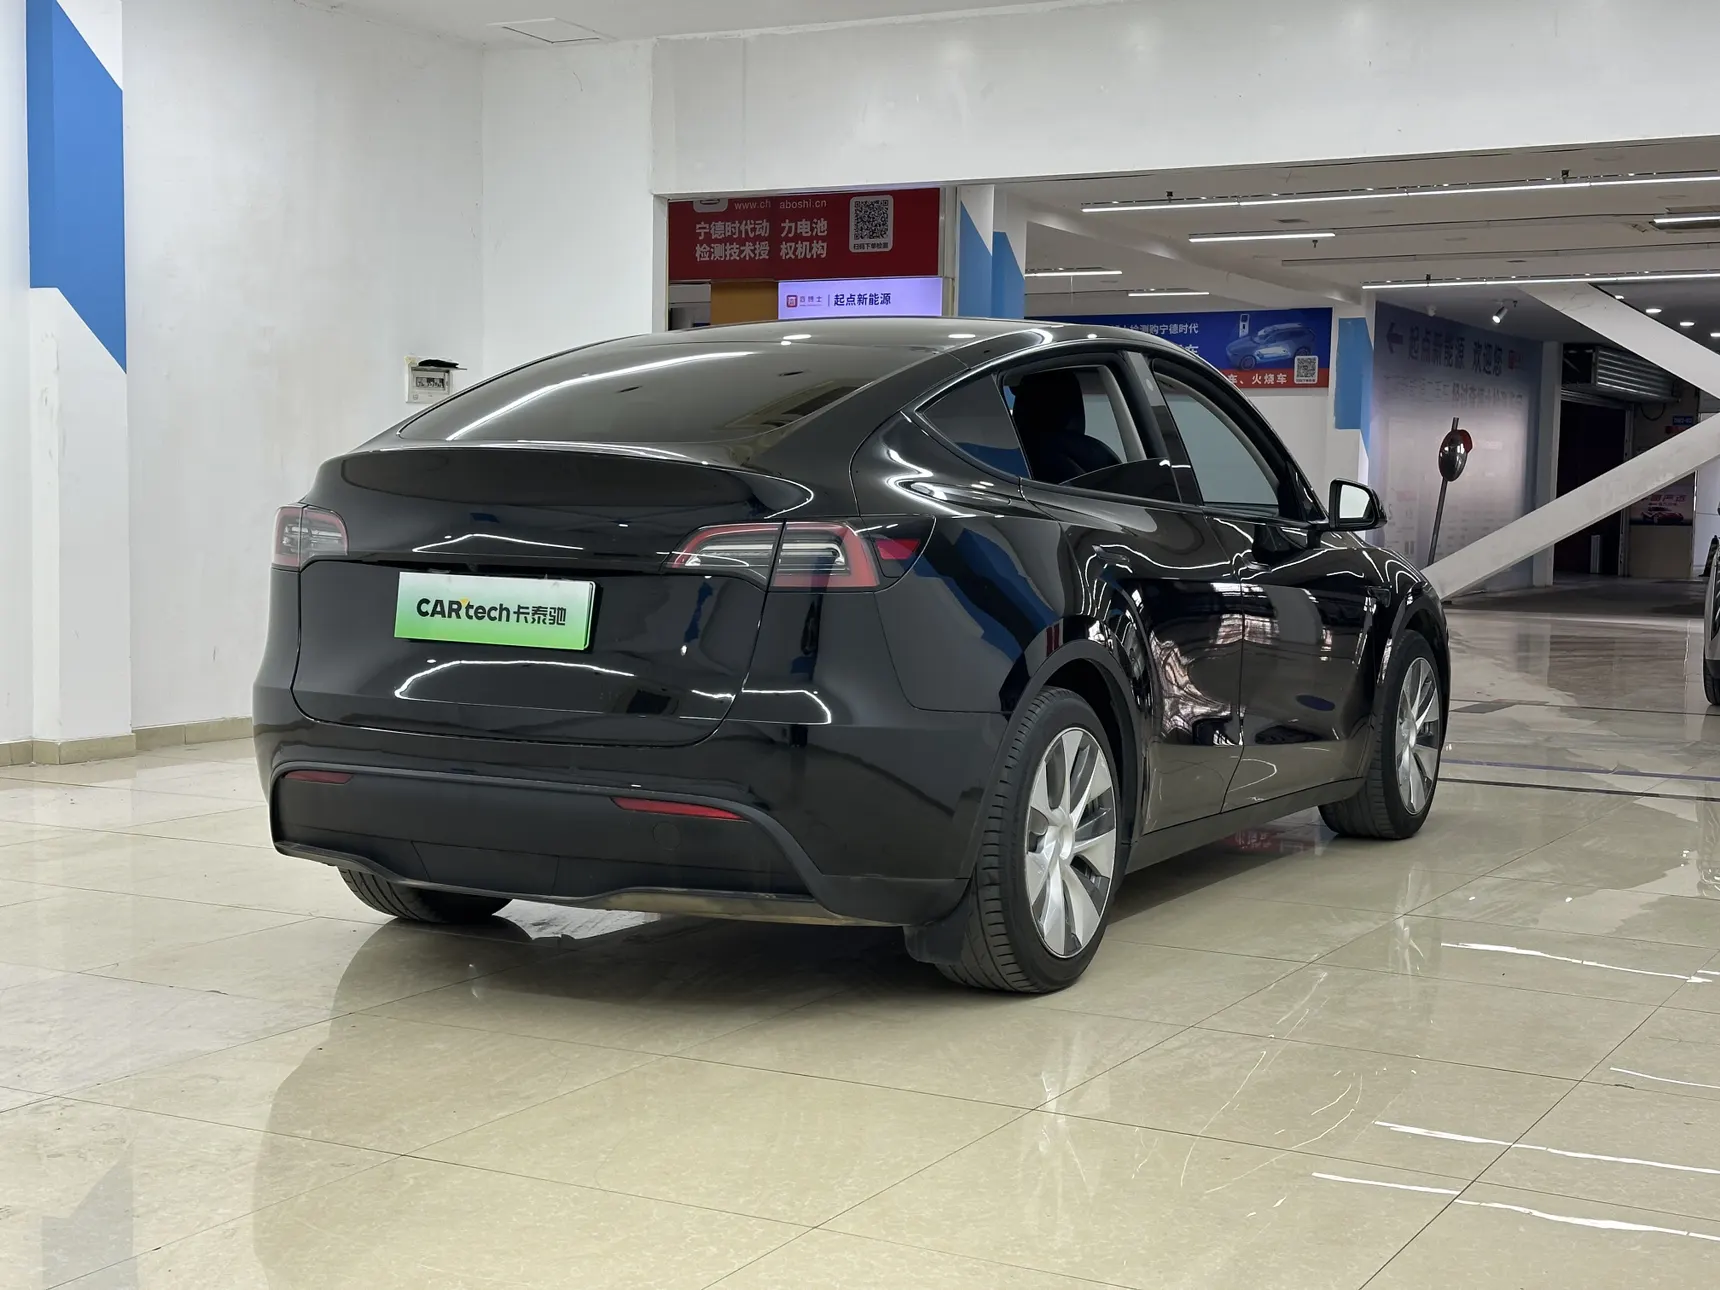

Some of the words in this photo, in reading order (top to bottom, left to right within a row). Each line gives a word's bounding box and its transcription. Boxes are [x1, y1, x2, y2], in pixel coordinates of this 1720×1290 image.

[695, 219, 770, 240] 宁德时代动
[780, 218, 828, 238] 力电池
[695, 241, 770, 262] 检测技术授
[780, 240, 827, 260] 权机构
[833, 293, 891, 307] 起点新能源
[416, 597, 510, 623] CARtech
[513, 604, 567, 626] 卡泰驰
